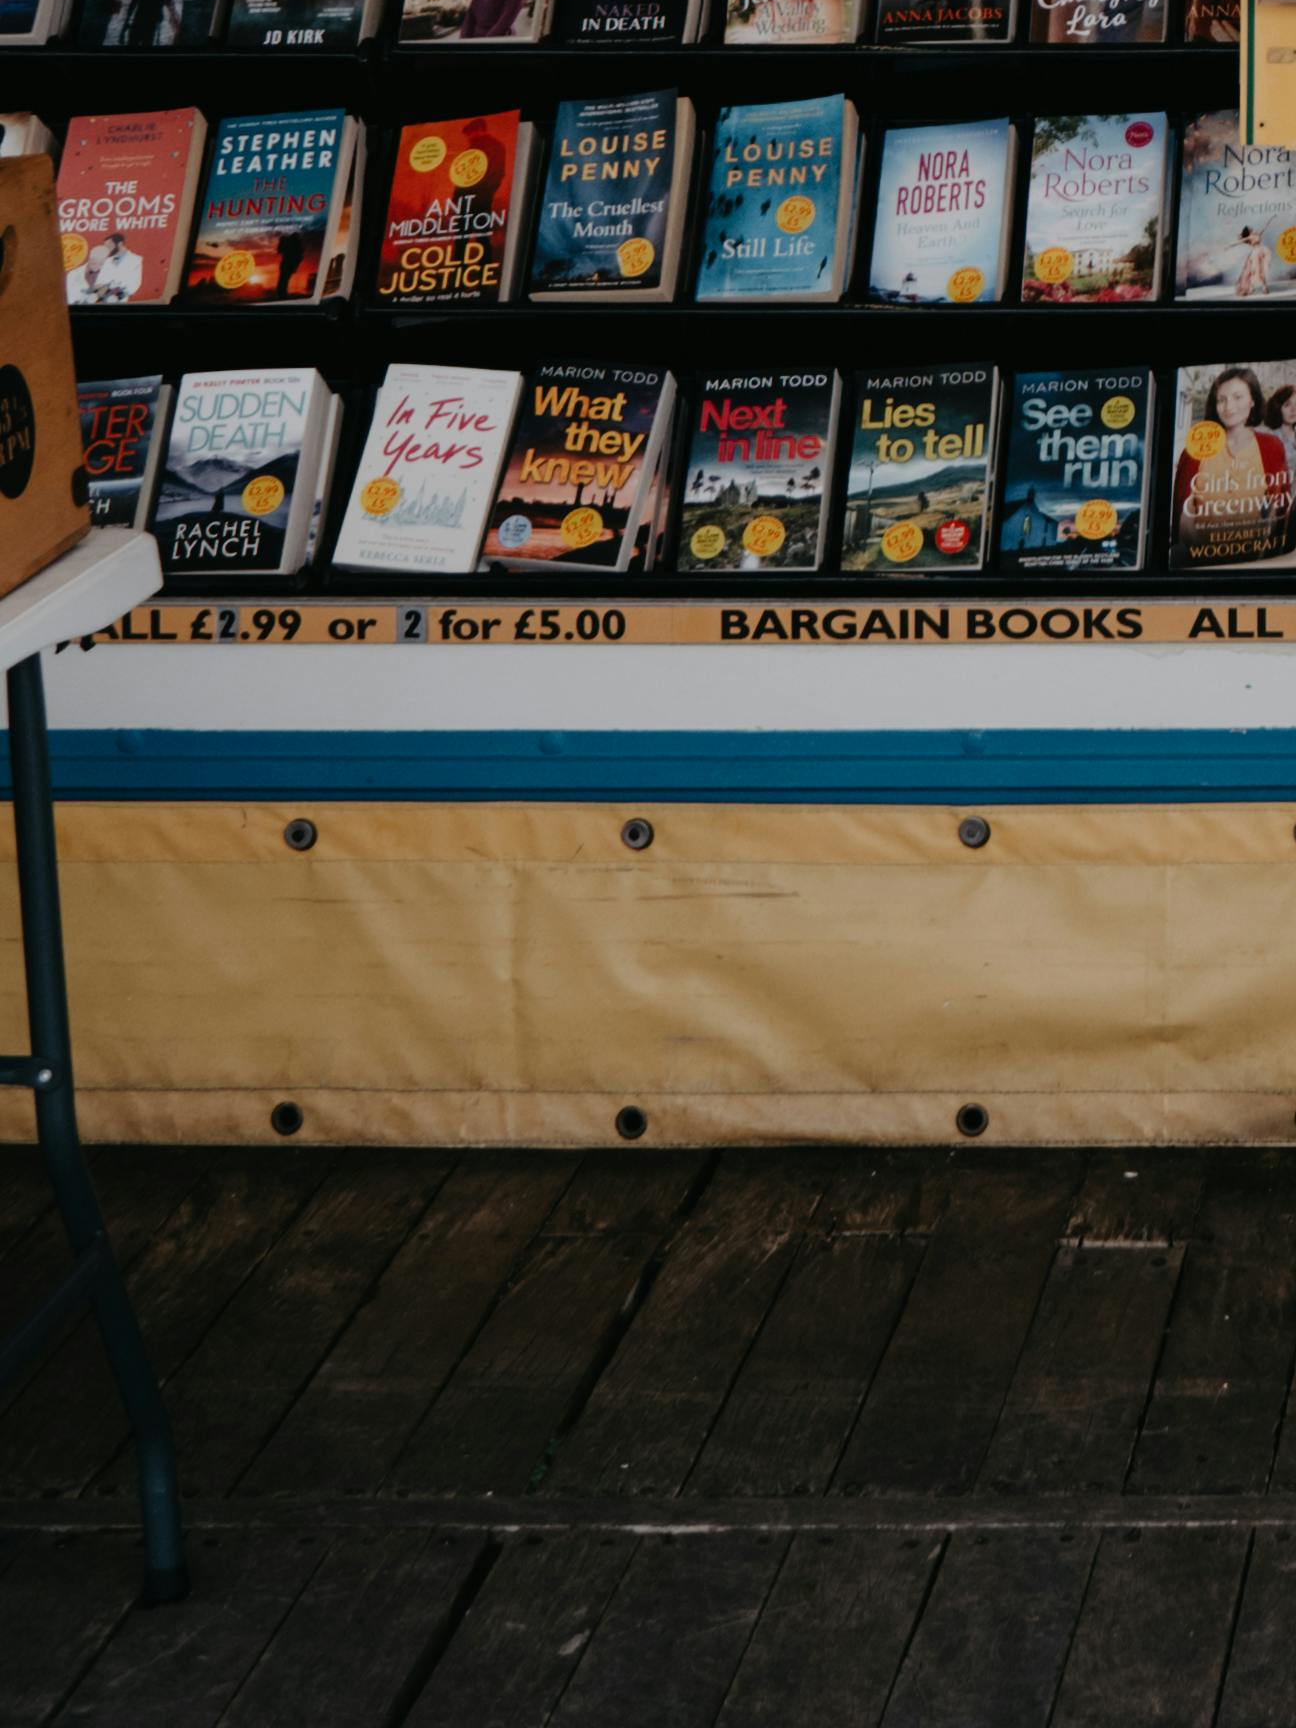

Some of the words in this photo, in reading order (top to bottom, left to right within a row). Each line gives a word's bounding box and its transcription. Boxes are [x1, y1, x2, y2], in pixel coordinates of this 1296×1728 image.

[220, 128, 338, 155] STEPHEN
[560, 129, 667, 157] LOUISE
[216, 149, 334, 176] LEATHER
[561, 155, 662, 183] PENNY
[917, 149, 970, 181] NORA
[57, 192, 176, 220] GROOMS
[896, 177, 987, 217] ROBERTS
[399, 240, 486, 272] COLD
[722, 237, 767, 260] Still
[773, 235, 815, 258] Life
[379, 261, 499, 294] JUSTICE
[540, 365, 606, 381] MARION
[611, 368, 659, 386] TODD
[179, 389, 307, 424] SUDDEN
[386, 395, 413, 429] In
[424, 402, 498, 433] Five
[533, 385, 627, 421] What
[701, 399, 786, 434] Next
[860, 400, 936, 431] Lies
[1022, 398, 1094, 431] See
[187, 423, 286, 454] DEATH
[564, 419, 646, 463] they
[876, 432, 914, 464] to
[922, 425, 985, 460] tell
[1039, 429, 1139, 463] them
[519, 449, 635, 490] knew
[1064, 458, 1140, 491] run
[174, 520, 262, 540] RACHEL
[171, 536, 260, 561] LYNCH
[190, 609, 301, 643] £2.99
[328, 615, 377, 641] or
[403, 610, 421, 638] 2
[439, 609, 501, 640] for
[515, 608, 626, 641] £5.00
[720, 609, 950, 641] BARGAIN
[967, 608, 1143, 638] BOOKS
[1188, 608, 1284, 638] ALL
